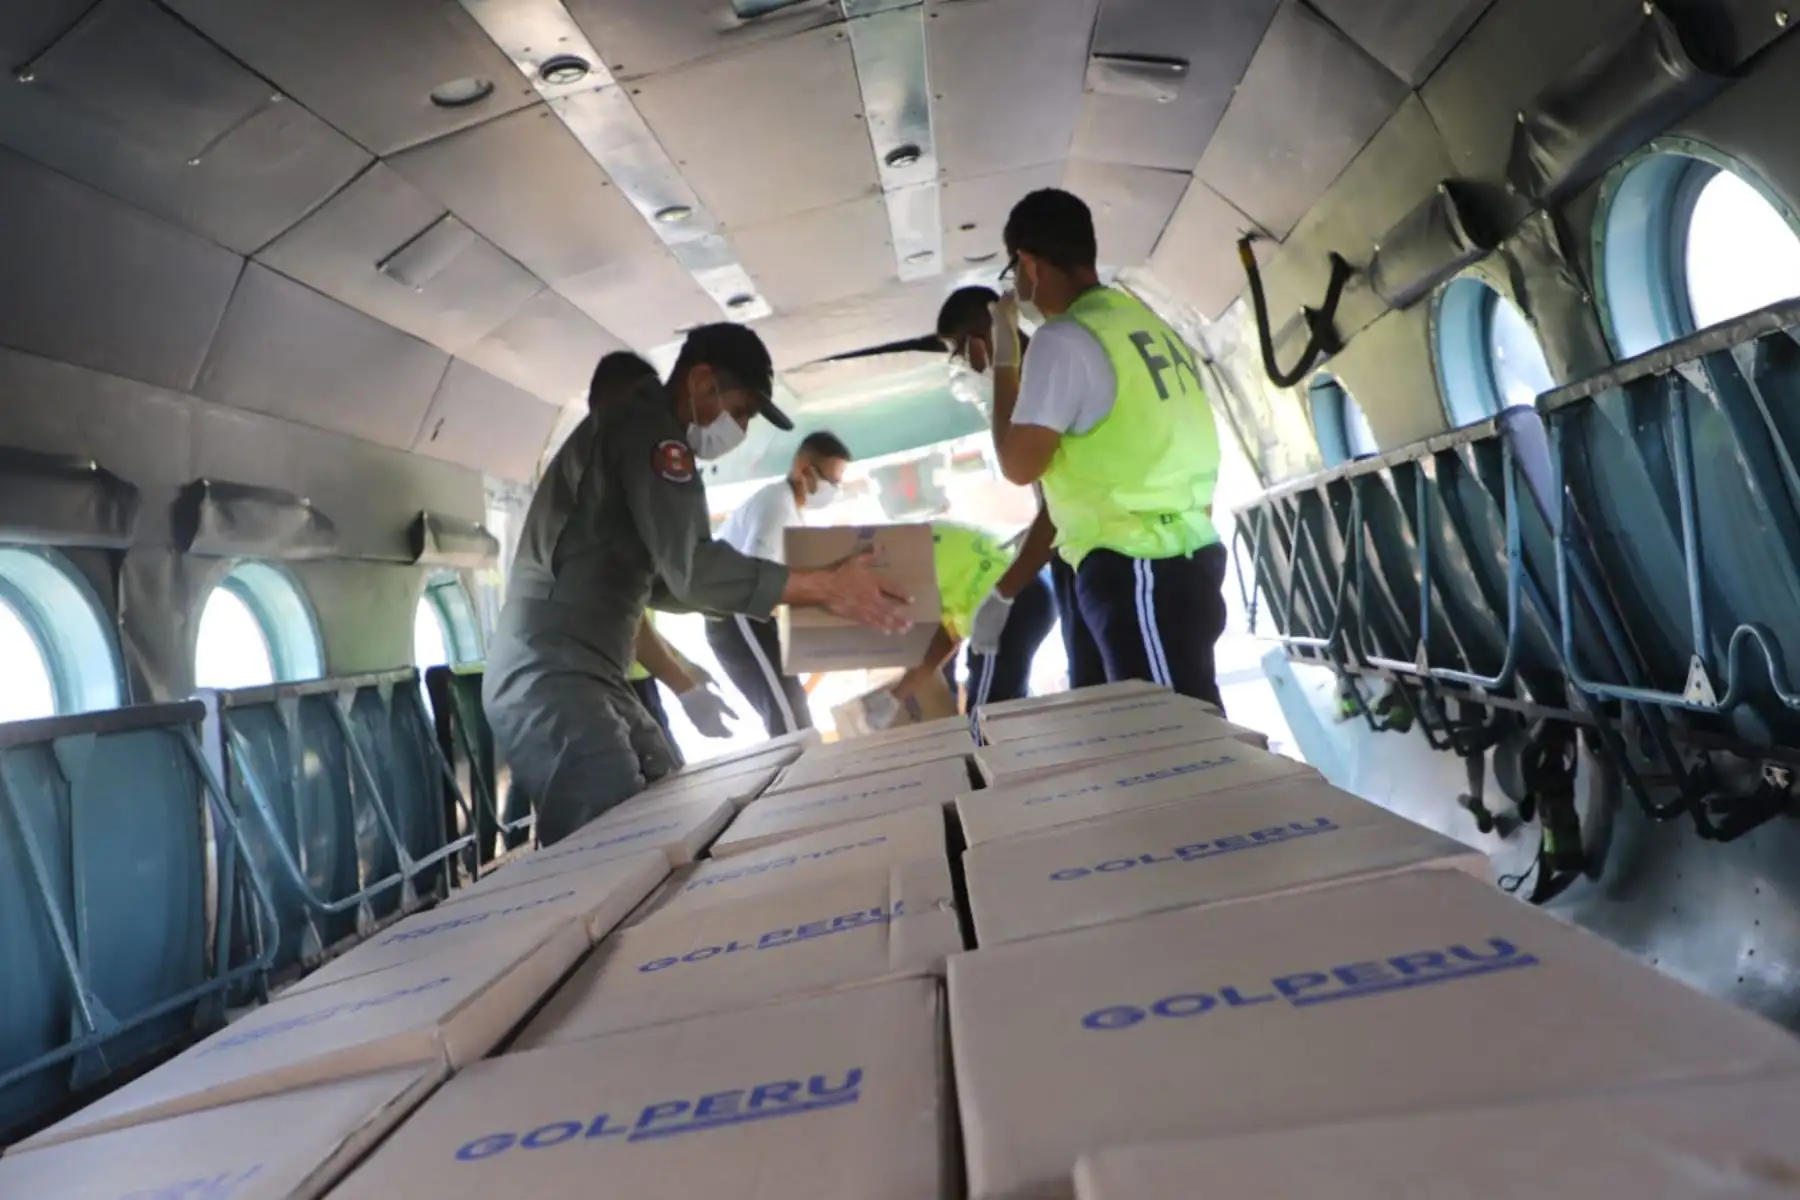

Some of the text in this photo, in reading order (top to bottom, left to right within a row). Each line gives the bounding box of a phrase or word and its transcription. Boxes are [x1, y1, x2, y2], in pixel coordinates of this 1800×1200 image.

[1127, 330, 1203, 401] FA
[1048, 815, 1340, 882] GOLPERU
[637, 899, 905, 974] GOLPERU
[1081, 936, 1540, 1030] GOLPERU
[454, 1067, 863, 1163] GOLPERU
